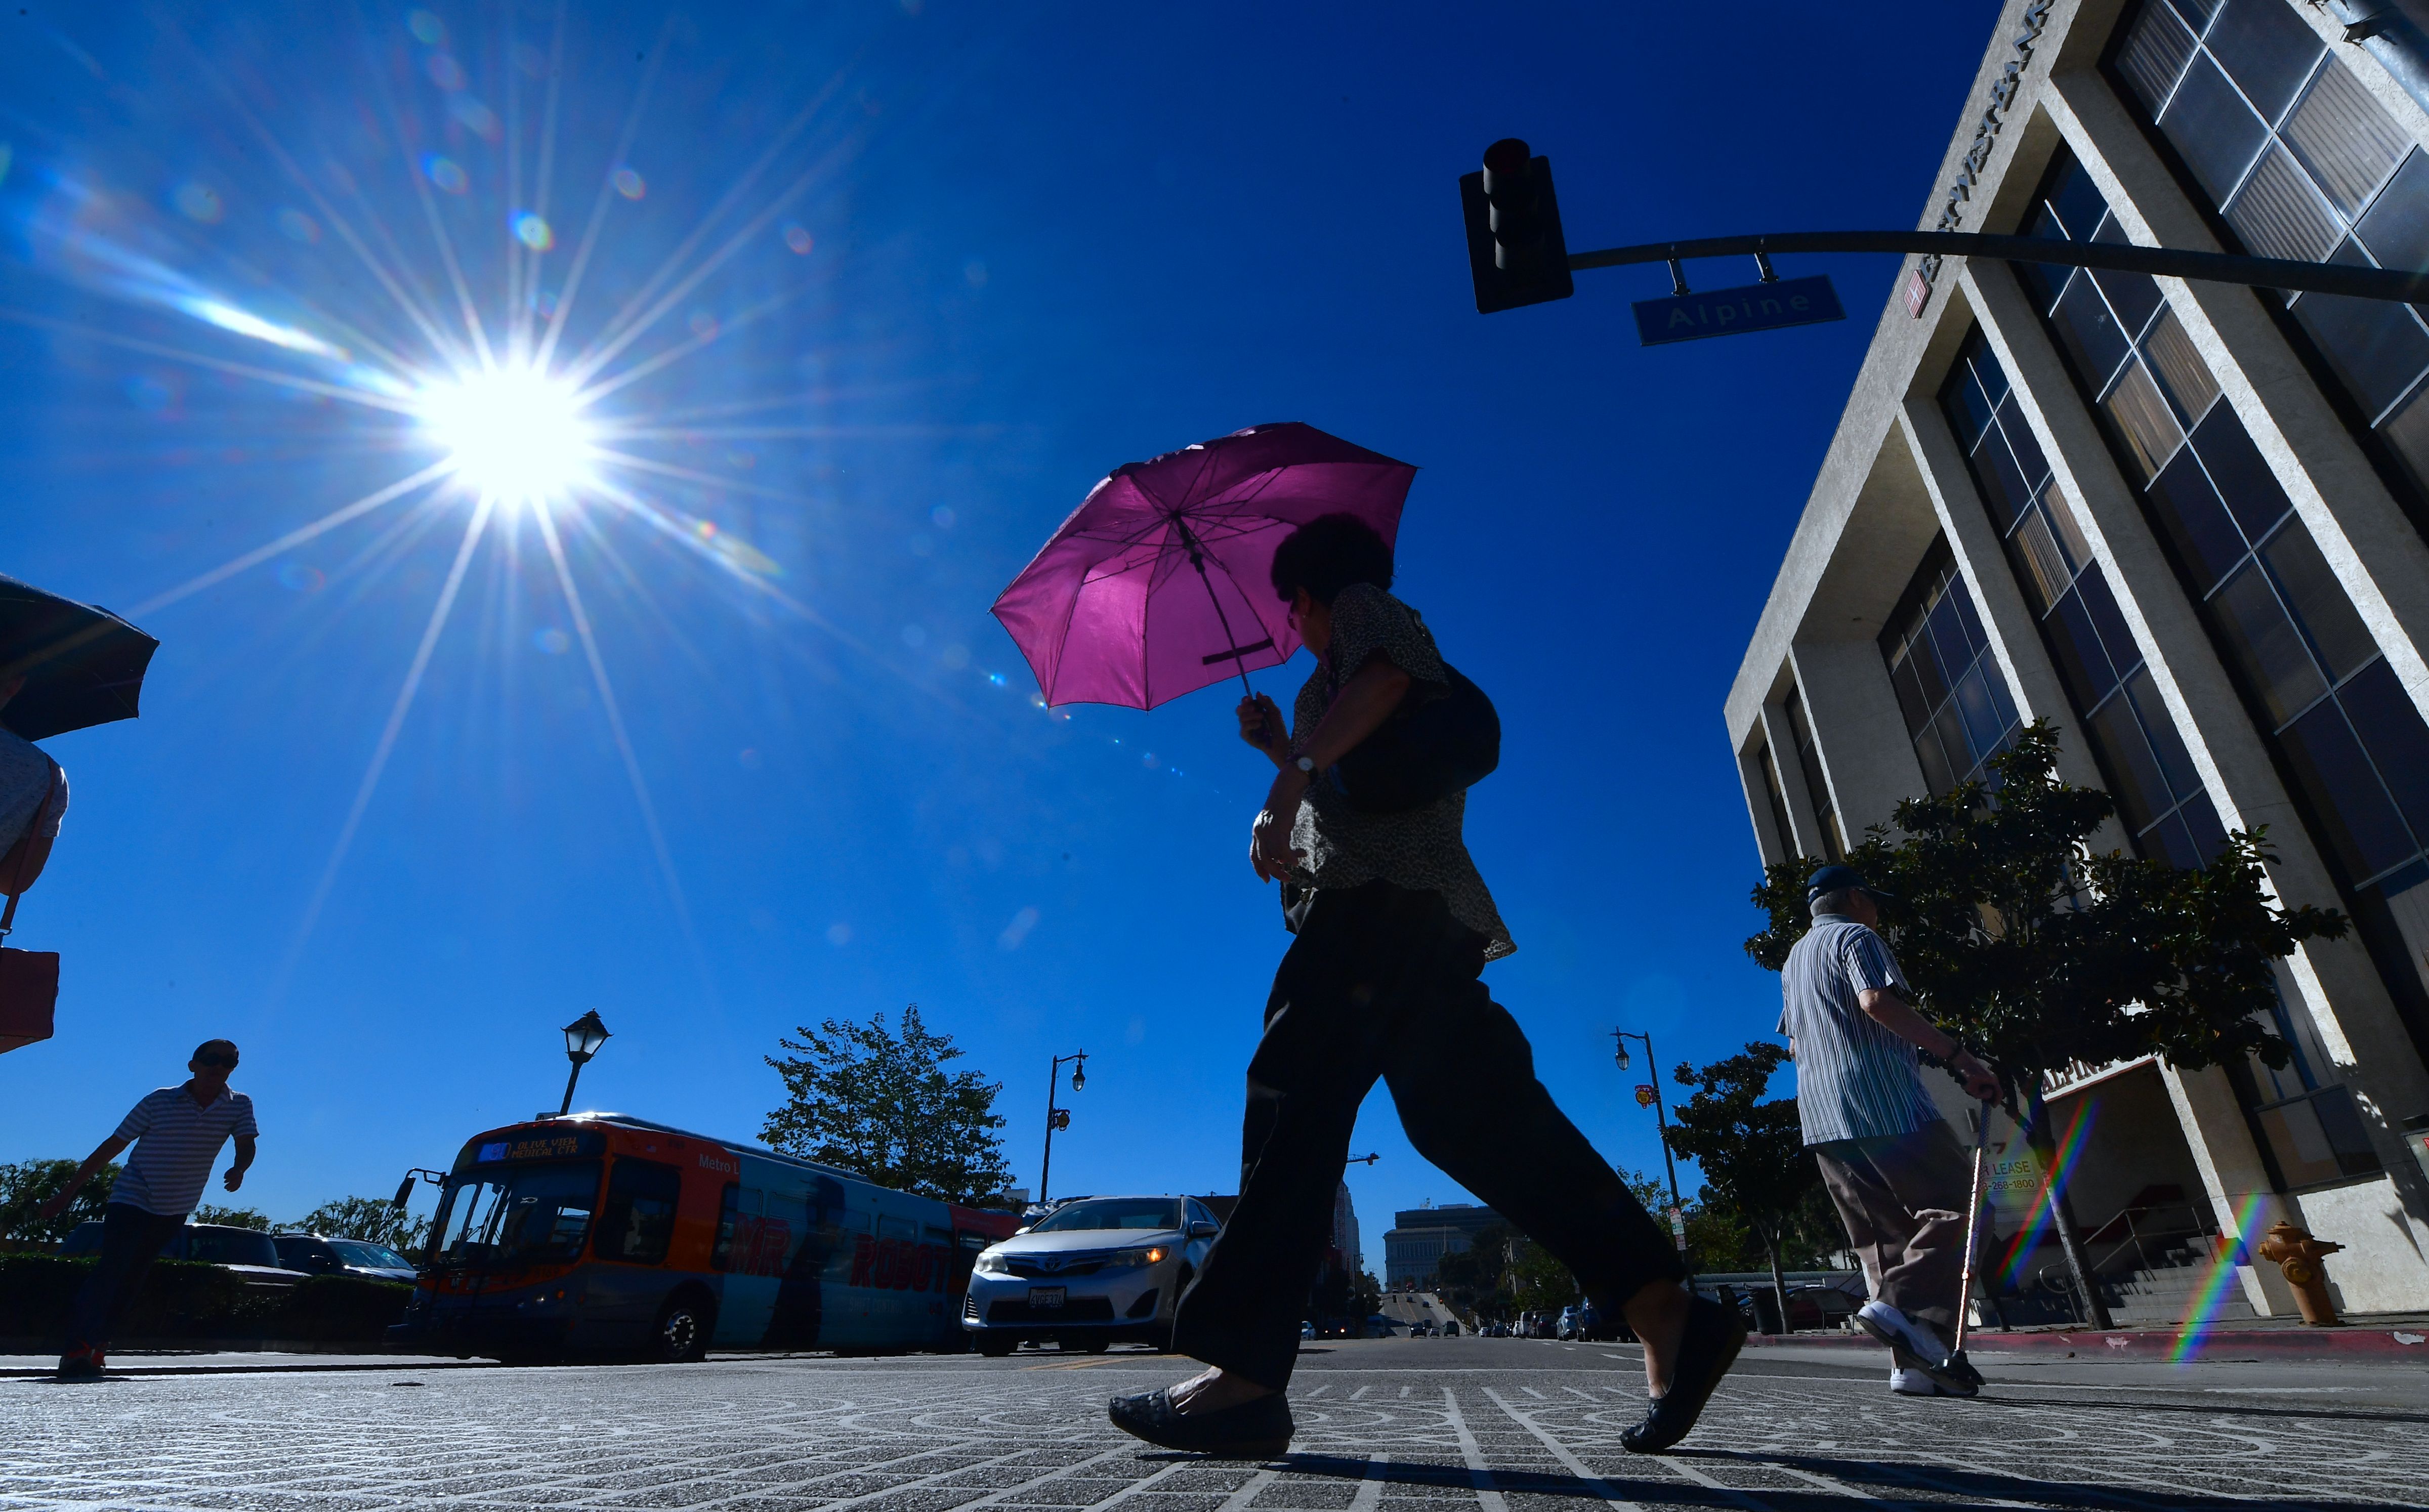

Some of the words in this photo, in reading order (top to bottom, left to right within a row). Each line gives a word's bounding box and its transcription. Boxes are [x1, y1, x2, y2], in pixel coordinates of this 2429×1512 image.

[1668, 295, 1810, 329] Alpine
[511, 1147, 553, 1158] MEDICAL
[558, 1145, 578, 1155] CTR
[518, 1139, 548, 1150] OLIVE
[551, 1137, 577, 1147] VIEW
[698, 1153, 731, 1173] Metro
[1992, 1161, 2031, 1175] LEASE
[849, 1233, 952, 1293] ROBOT
